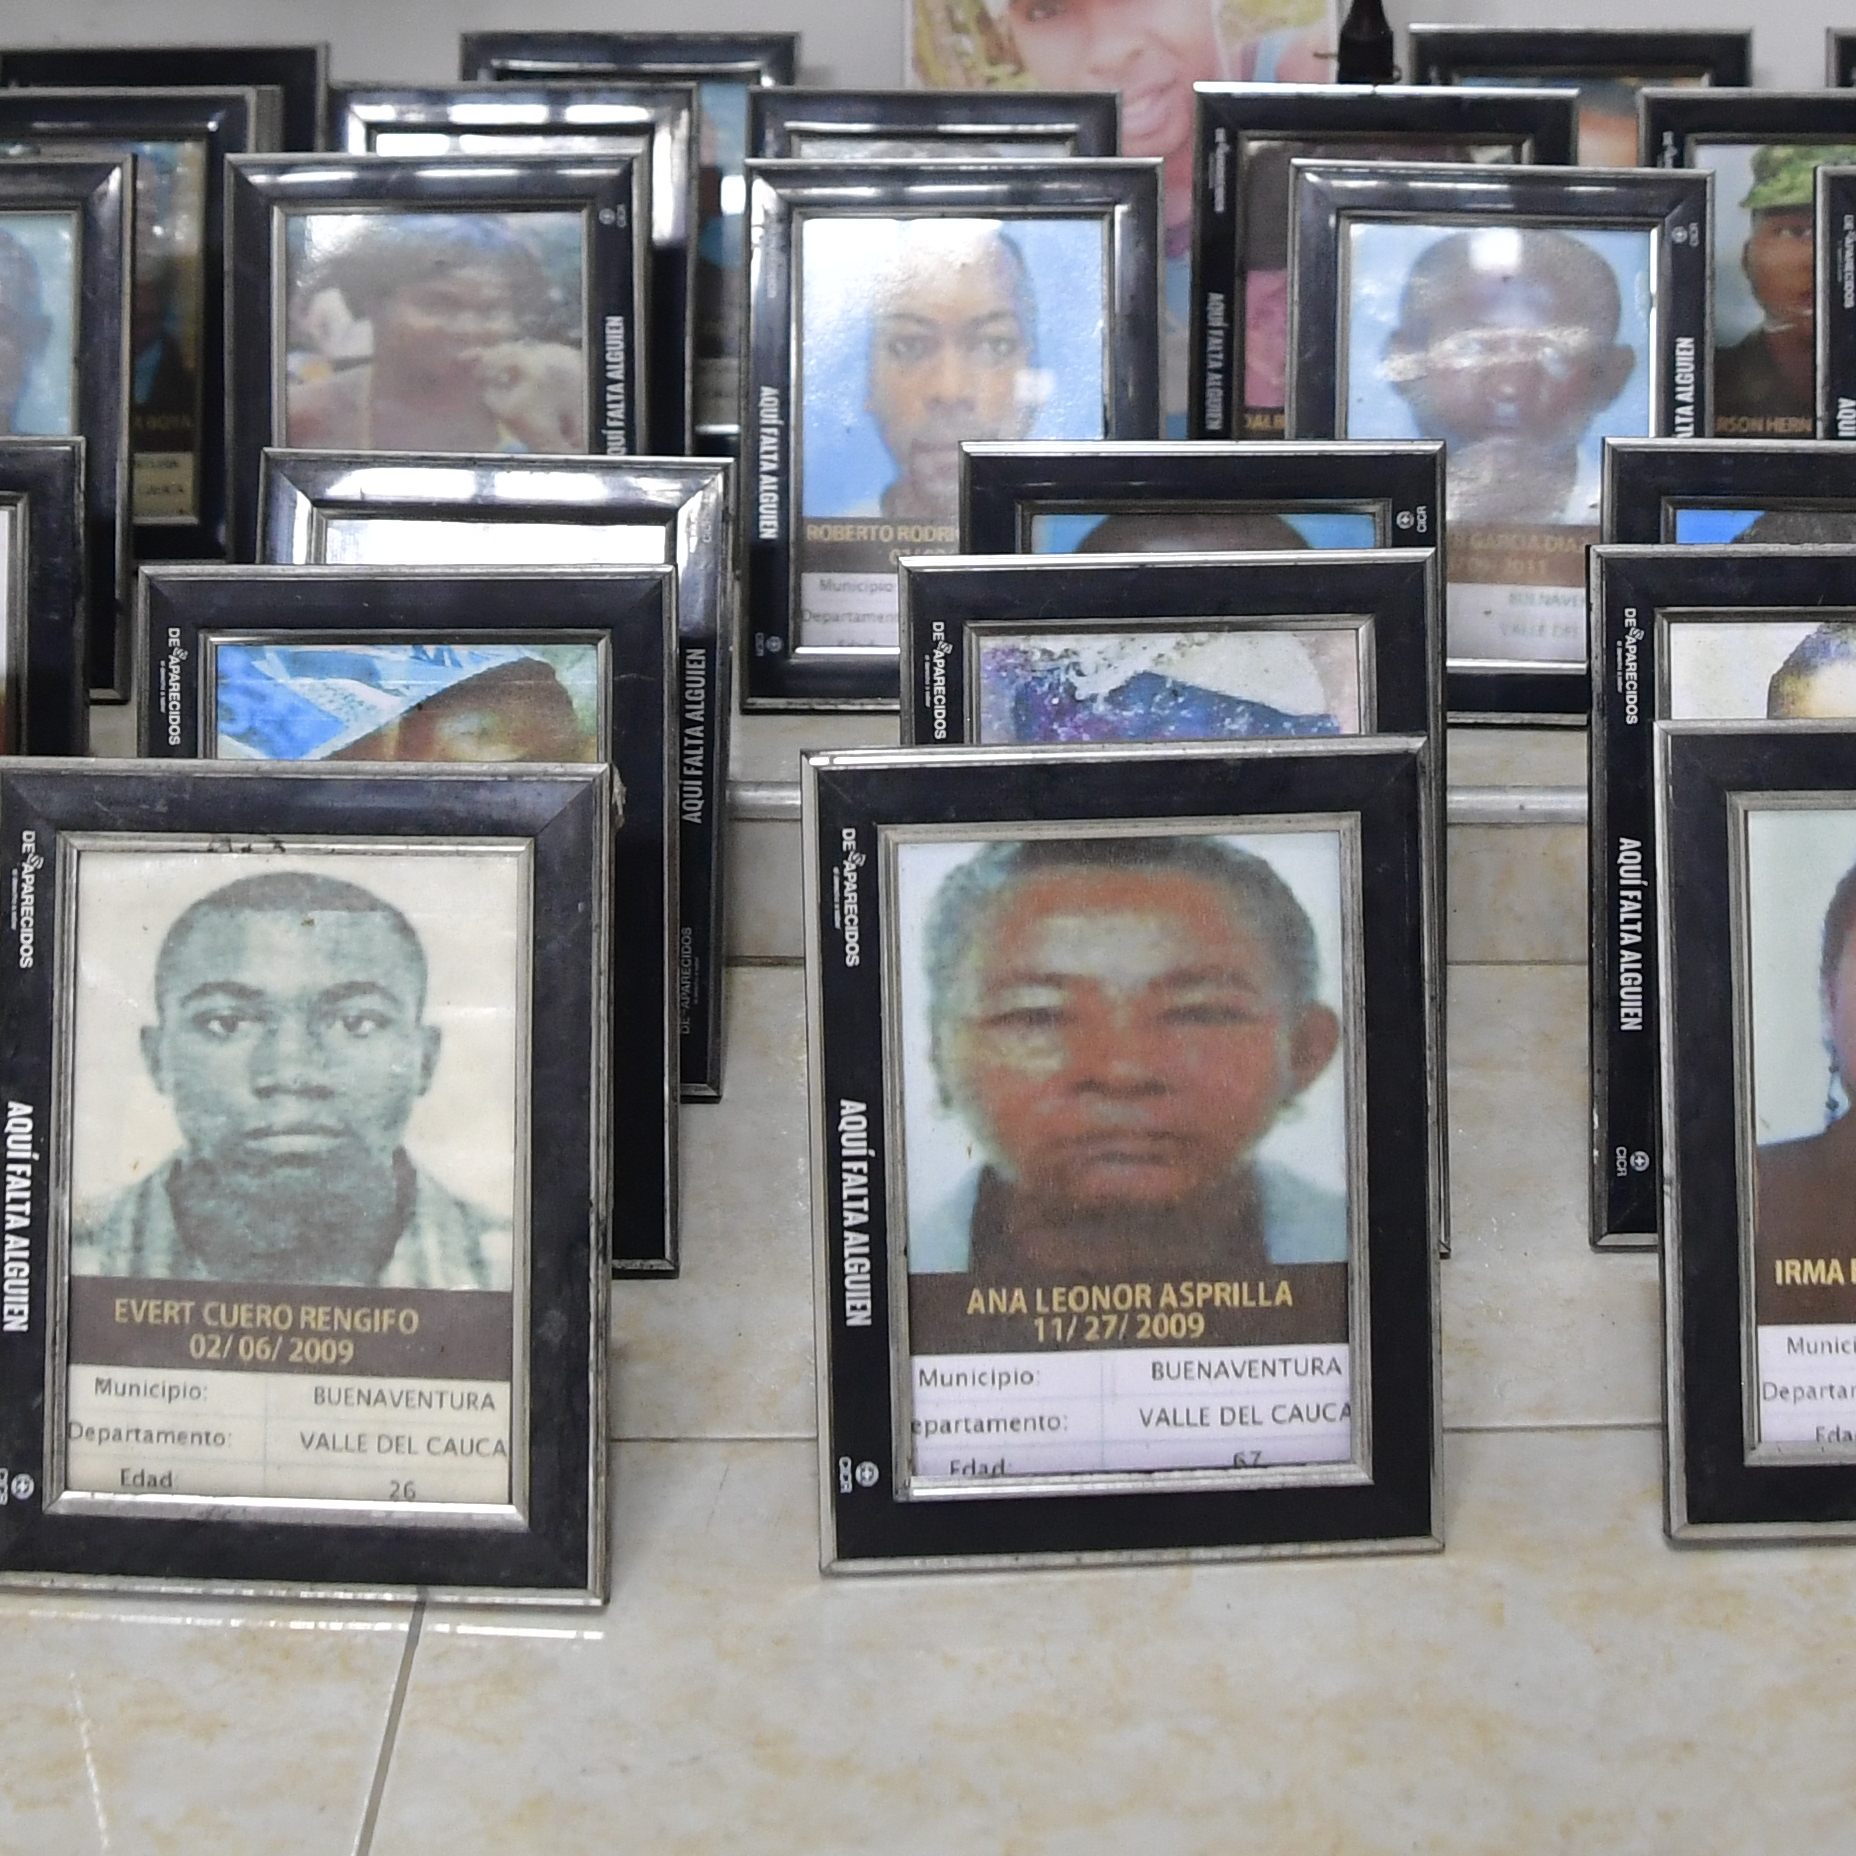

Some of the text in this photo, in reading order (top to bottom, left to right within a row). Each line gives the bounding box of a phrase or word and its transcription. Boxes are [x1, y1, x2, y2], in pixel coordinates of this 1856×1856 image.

[606, 316, 625, 427] FALTA ALGUIEN
[1675, 337, 1695, 402] ALGUIEN
[759, 428, 778, 471] FALTA
[759, 473, 778, 538] ALGUIEN
[807, 524, 894, 542] ROBERTO
[684, 648, 706, 722] ALGUIEN
[683, 725, 703, 774] FALTA
[1619, 836, 1647, 1031] AQUÍ FALTA ALGUIEN
[1616, 1146, 1627, 1177] CICR
[3, 1101, 40, 1332] AQUÍ FALTA ALGUIEN
[839, 1099, 875, 1327] AQUÍ FALTA ALGUIEN
[1775, 1258, 1844, 1286] IRMA
[967, 1280, 1293, 1315] ANA LEONOR ASPRILLA
[114, 1298, 419, 1335] EVERT CUERO RENGIFO
[1136, 1311, 1205, 1339] 2009
[289, 1336, 355, 1364] 2009
[919, 1356, 1342, 1391] Municipio: BUENAVENTURA
[94, 1377, 495, 1411] Municipio: BUENAVENTURA
[1139, 1402, 1352, 1429] VALLE DEL CAUCA
[68, 1420, 507, 1457] Departamento: VALLE DEL CAUCA
[389, 1480, 417, 1502] 26
